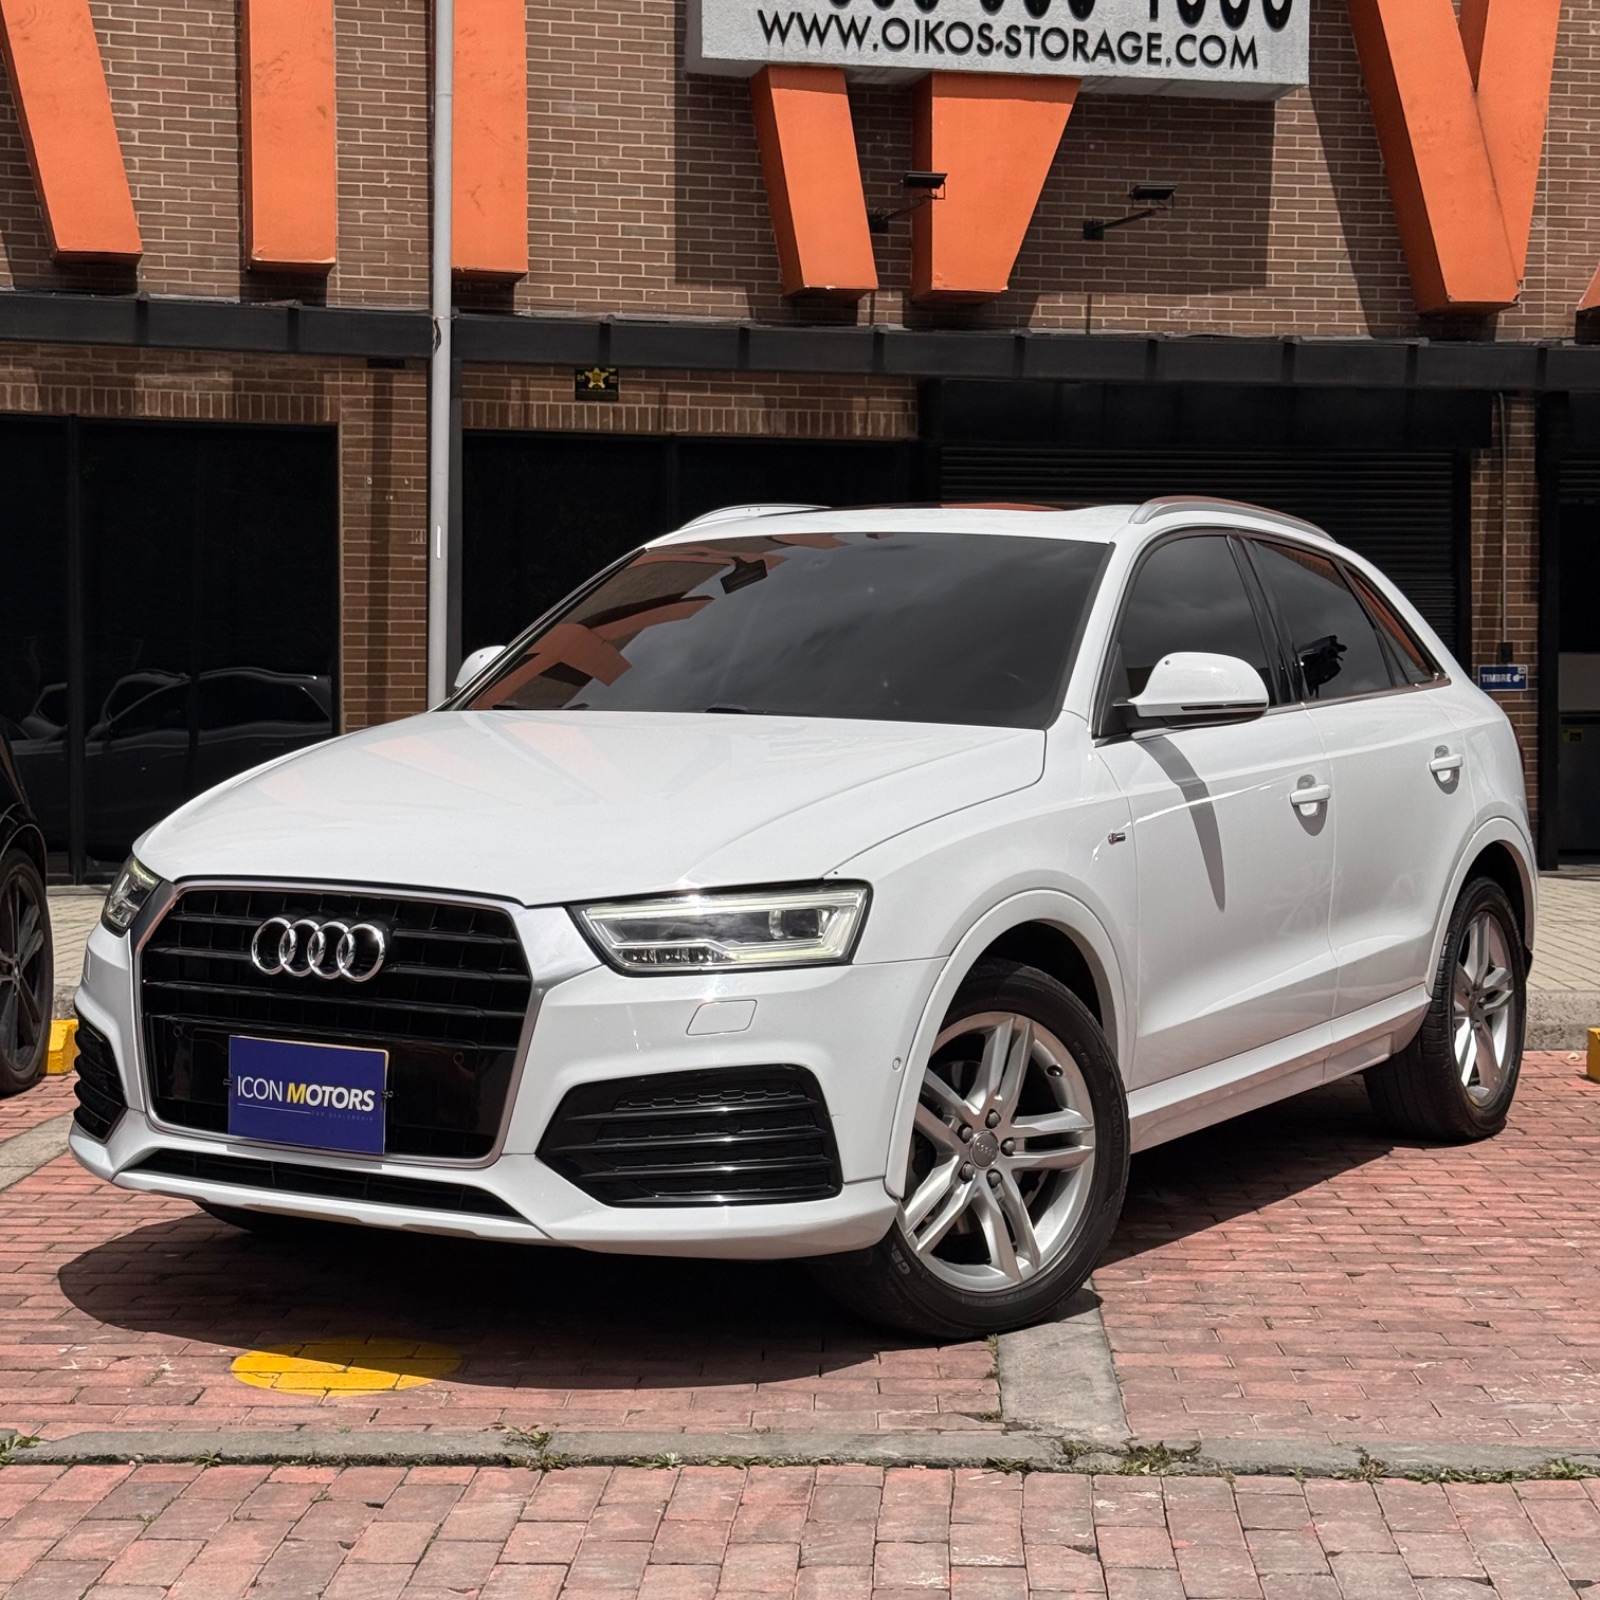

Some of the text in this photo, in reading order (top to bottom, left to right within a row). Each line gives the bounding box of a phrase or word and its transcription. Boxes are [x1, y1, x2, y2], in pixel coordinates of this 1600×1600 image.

[1481, 673, 1512, 683] TIMBRE
[237, 1075, 376, 1112] ICON MOTORS
